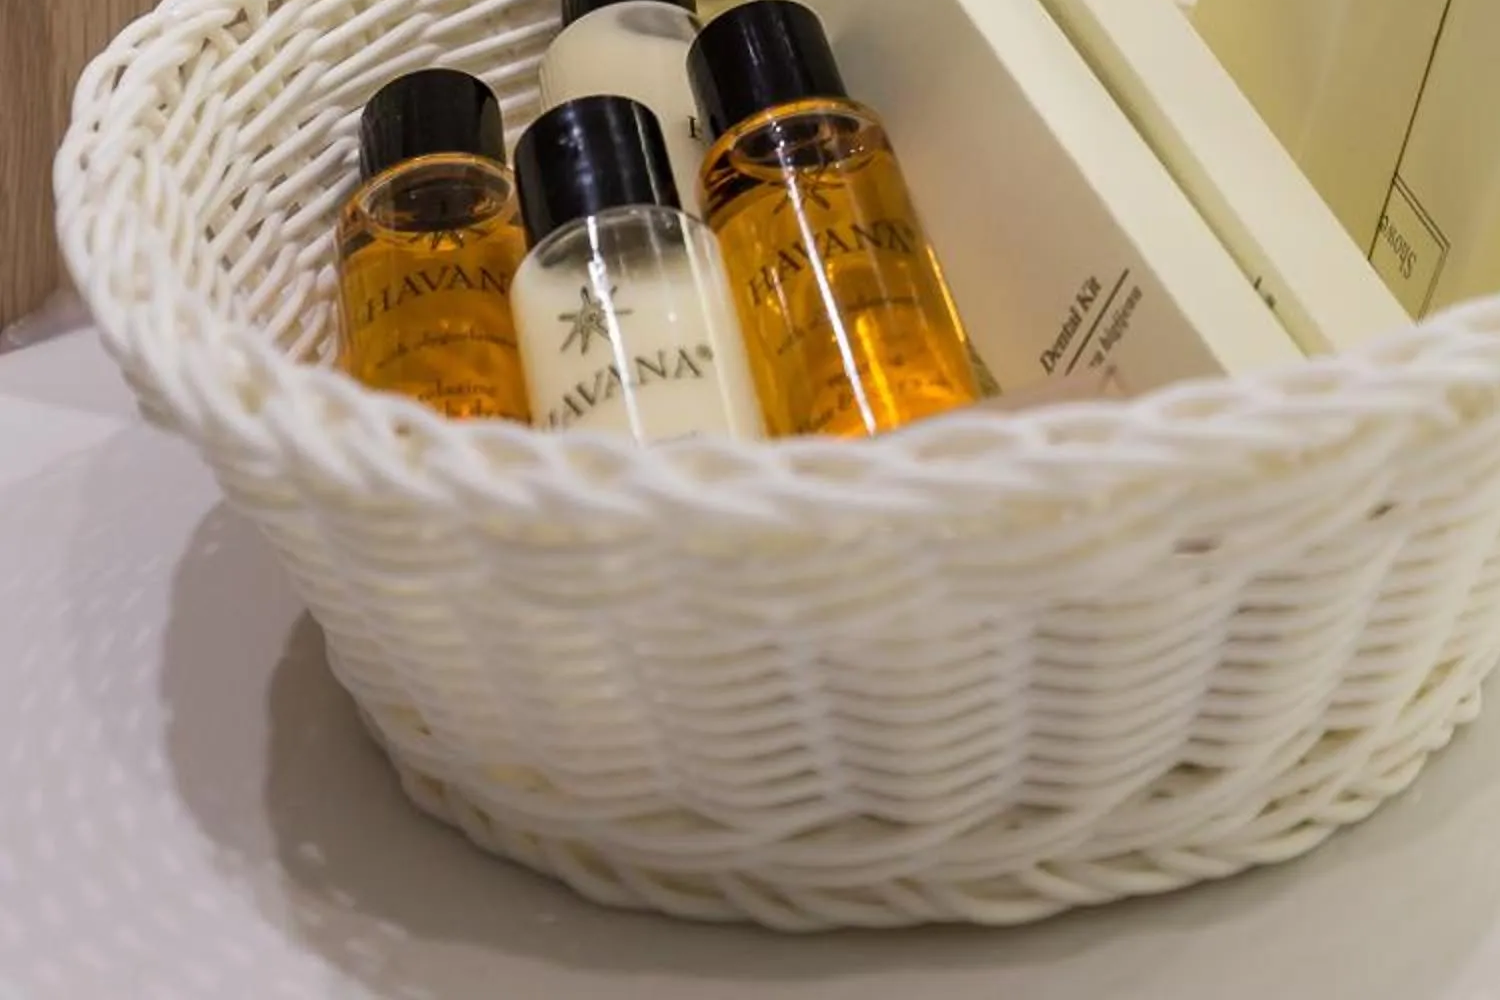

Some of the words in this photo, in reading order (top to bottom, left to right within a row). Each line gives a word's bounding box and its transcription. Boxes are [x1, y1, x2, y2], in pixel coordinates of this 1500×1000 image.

[1378, 214, 1417, 280] Showe
[362, 264, 510, 323] HAVAN
[1039, 307, 1083, 376] Dental
[1074, 275, 1102, 312] Kit
